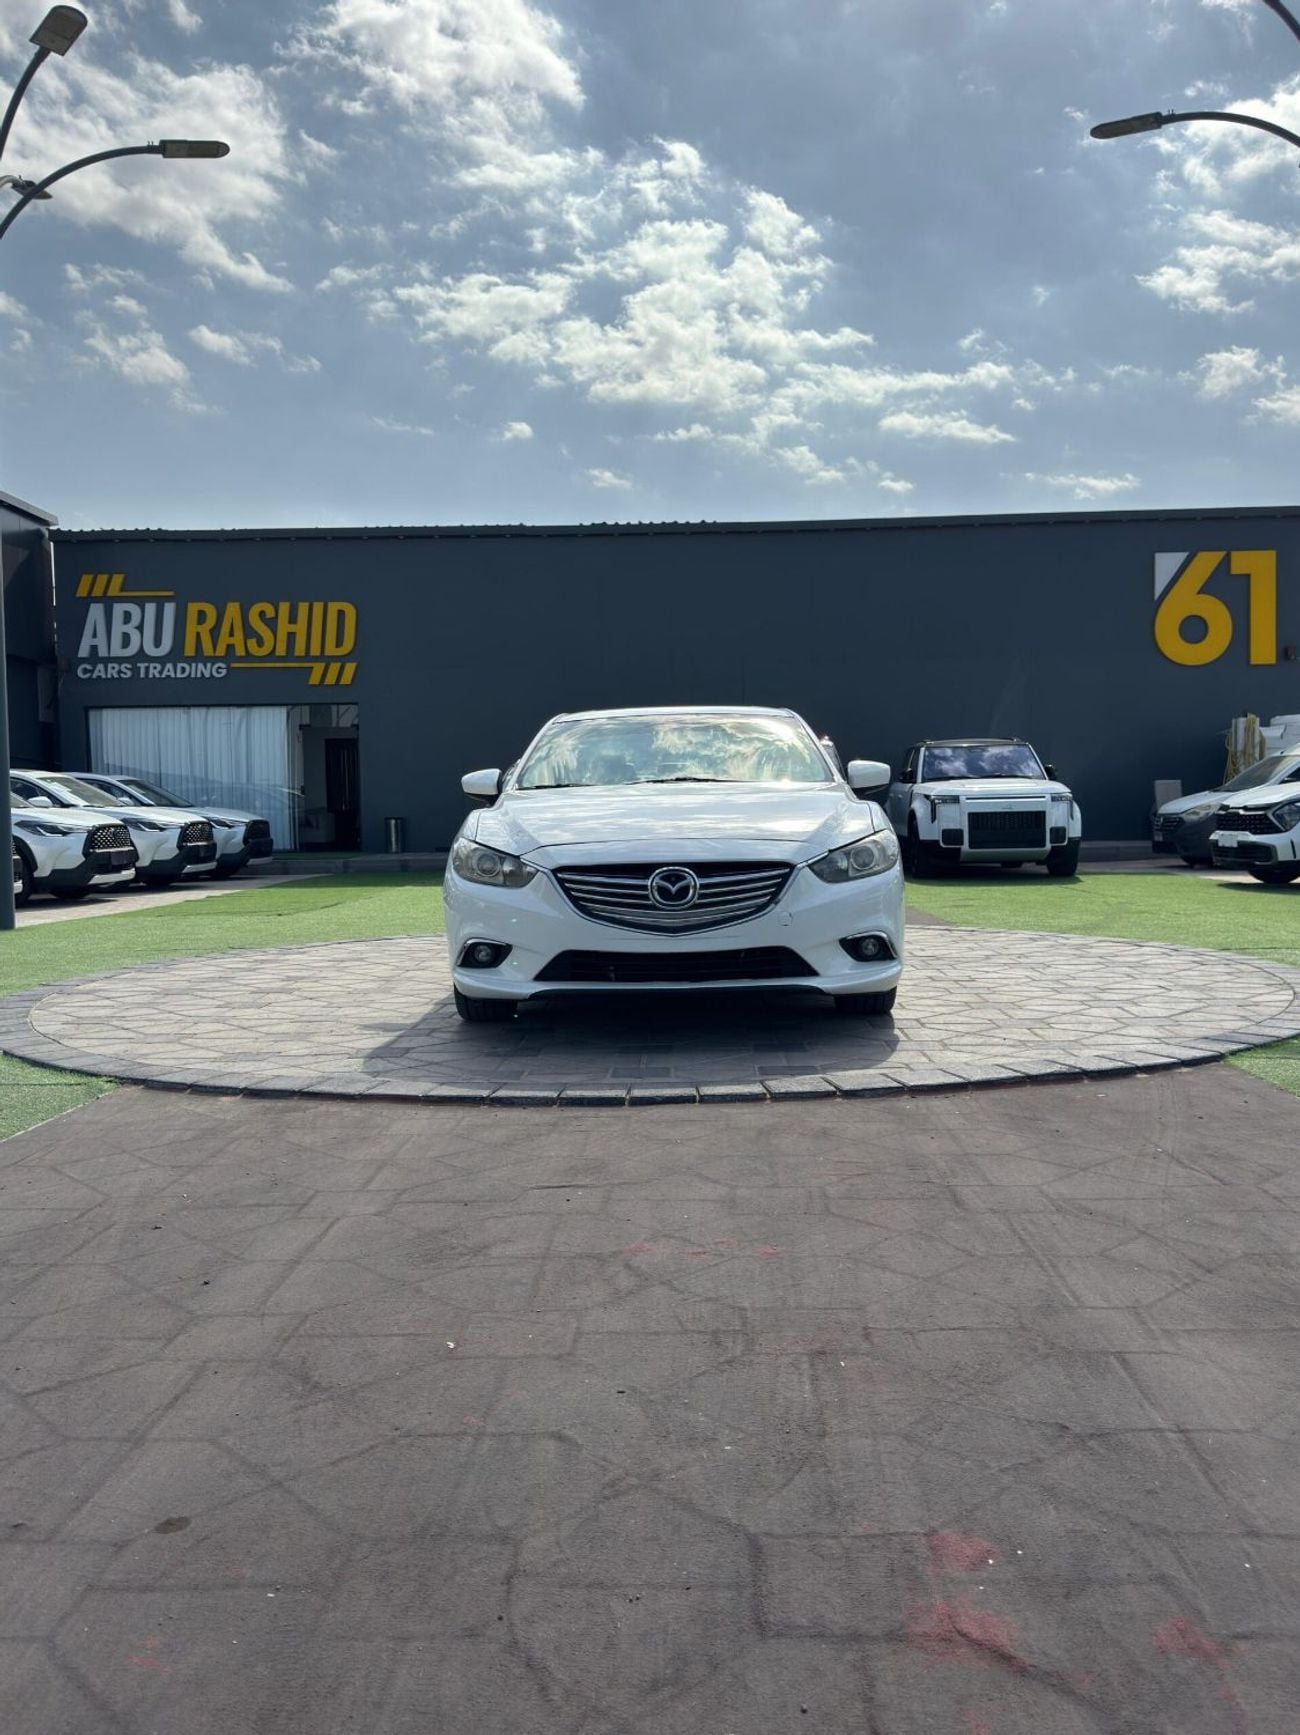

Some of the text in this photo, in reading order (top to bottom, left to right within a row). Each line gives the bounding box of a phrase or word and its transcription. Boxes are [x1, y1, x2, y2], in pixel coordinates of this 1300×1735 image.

[77, 601, 357, 658] ABU RASHID
[1154, 550, 1277, 666] 61
[76, 663, 228, 679] CARS TRADING
